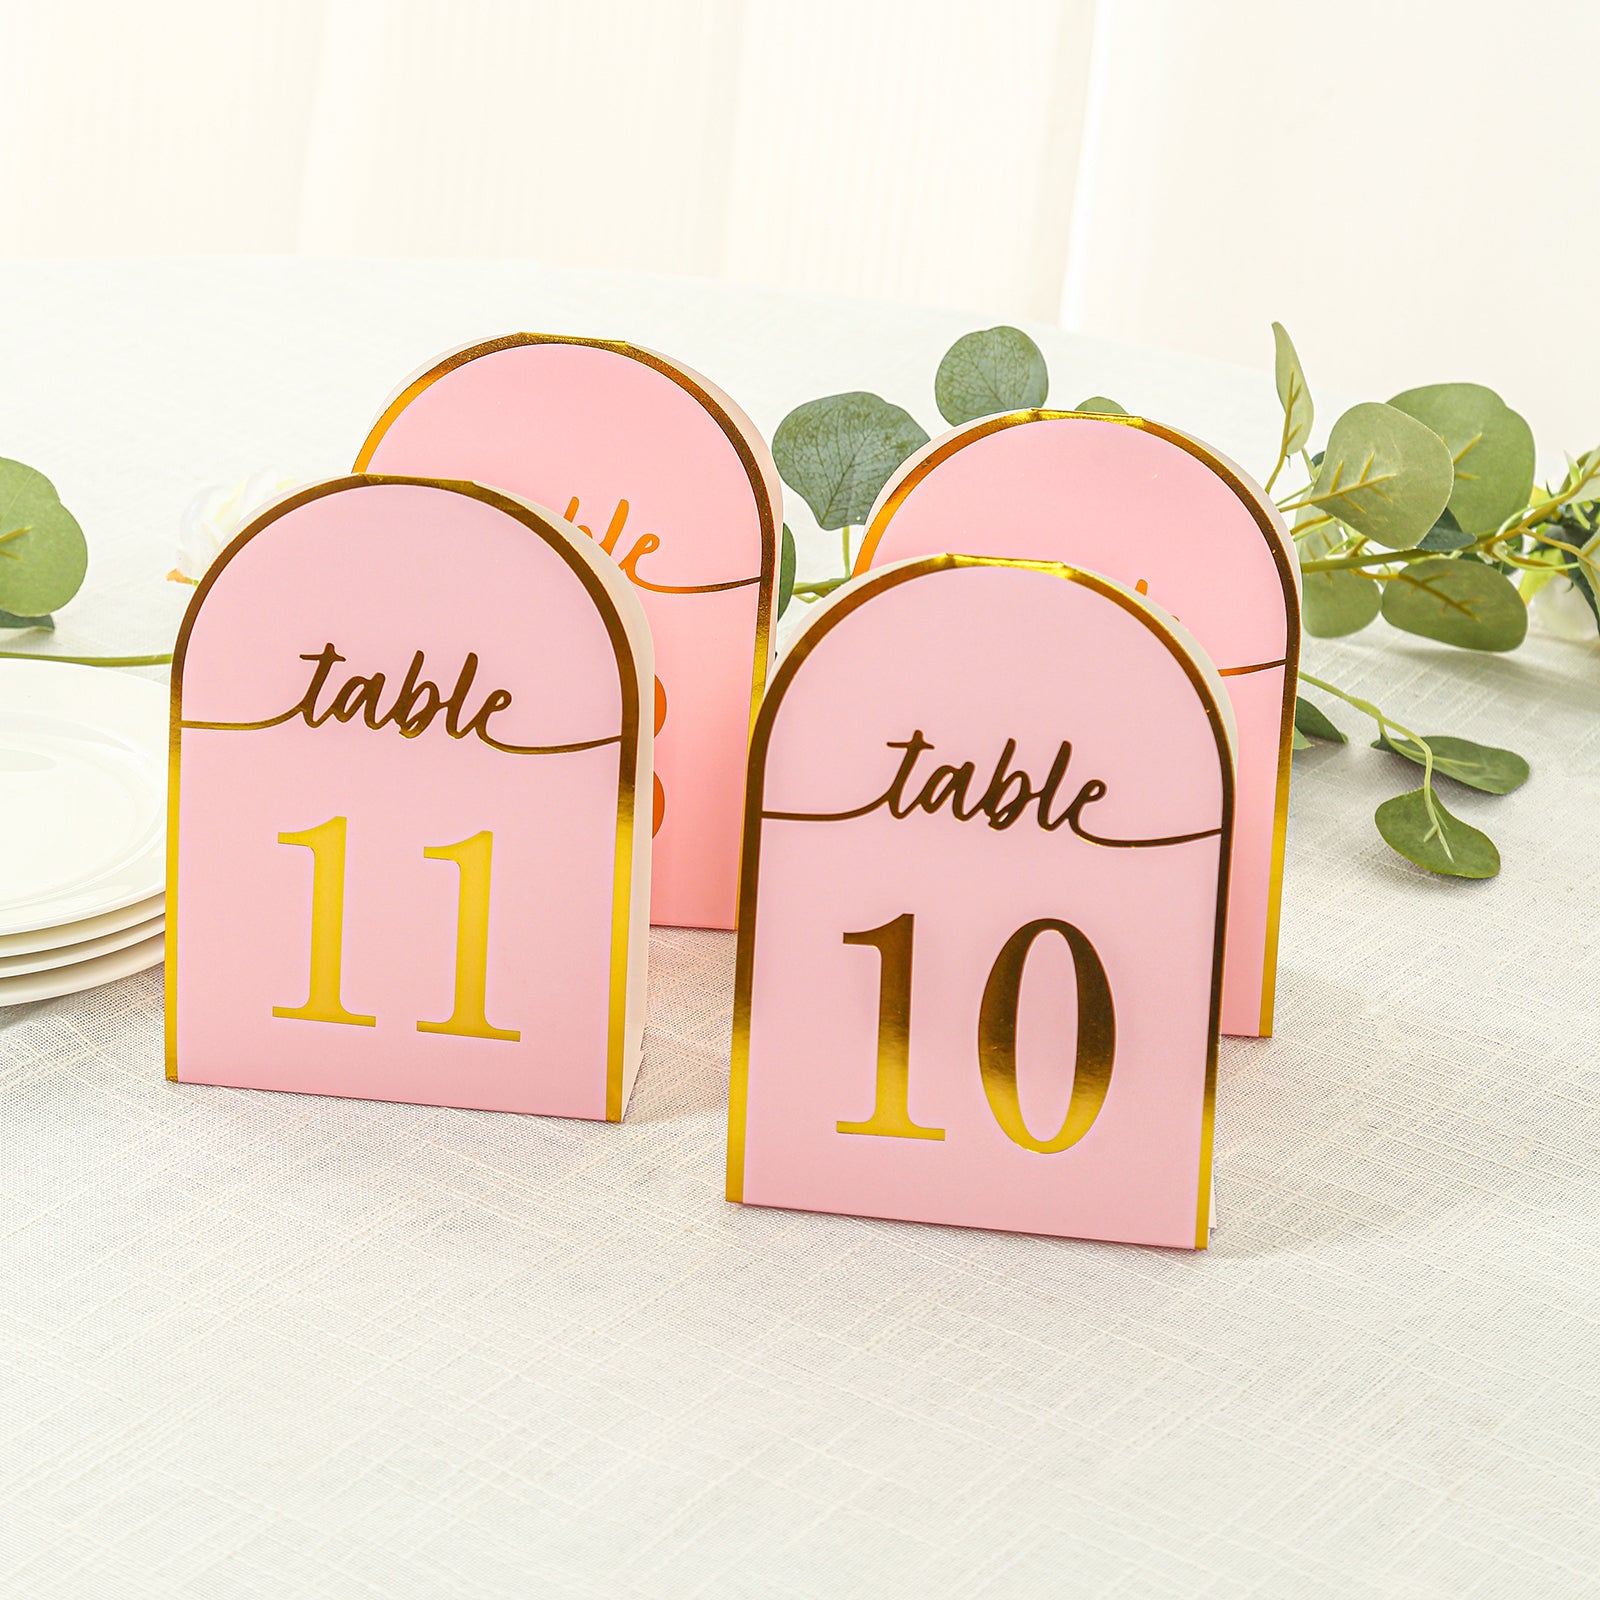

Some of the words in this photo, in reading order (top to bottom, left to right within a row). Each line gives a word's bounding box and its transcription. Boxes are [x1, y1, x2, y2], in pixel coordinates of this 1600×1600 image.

[294, 642, 524, 754] table
[880, 730, 1120, 848] table
[272, 815, 521, 1043] 11
[835, 913, 1117, 1155] 10
